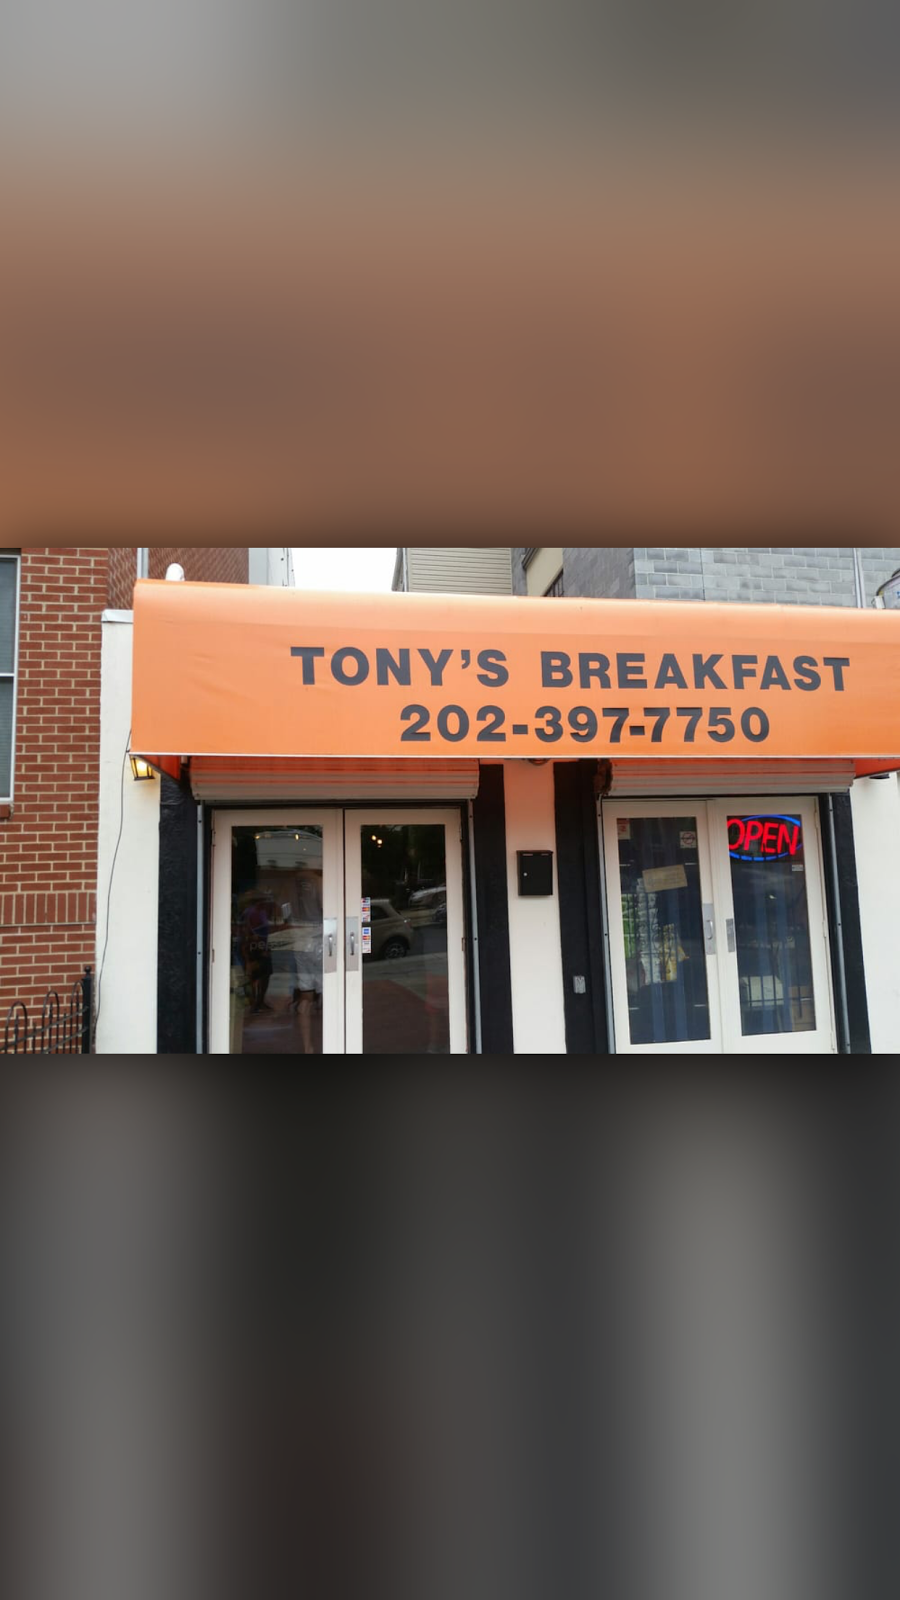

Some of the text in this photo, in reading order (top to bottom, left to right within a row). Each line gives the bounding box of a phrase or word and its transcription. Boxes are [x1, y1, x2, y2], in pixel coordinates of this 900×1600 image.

[290, 646, 850, 692] TONY'S BREAKFAST
[400, 703, 770, 743] 202-397-7750
[727, 818, 800, 856] OPEN
